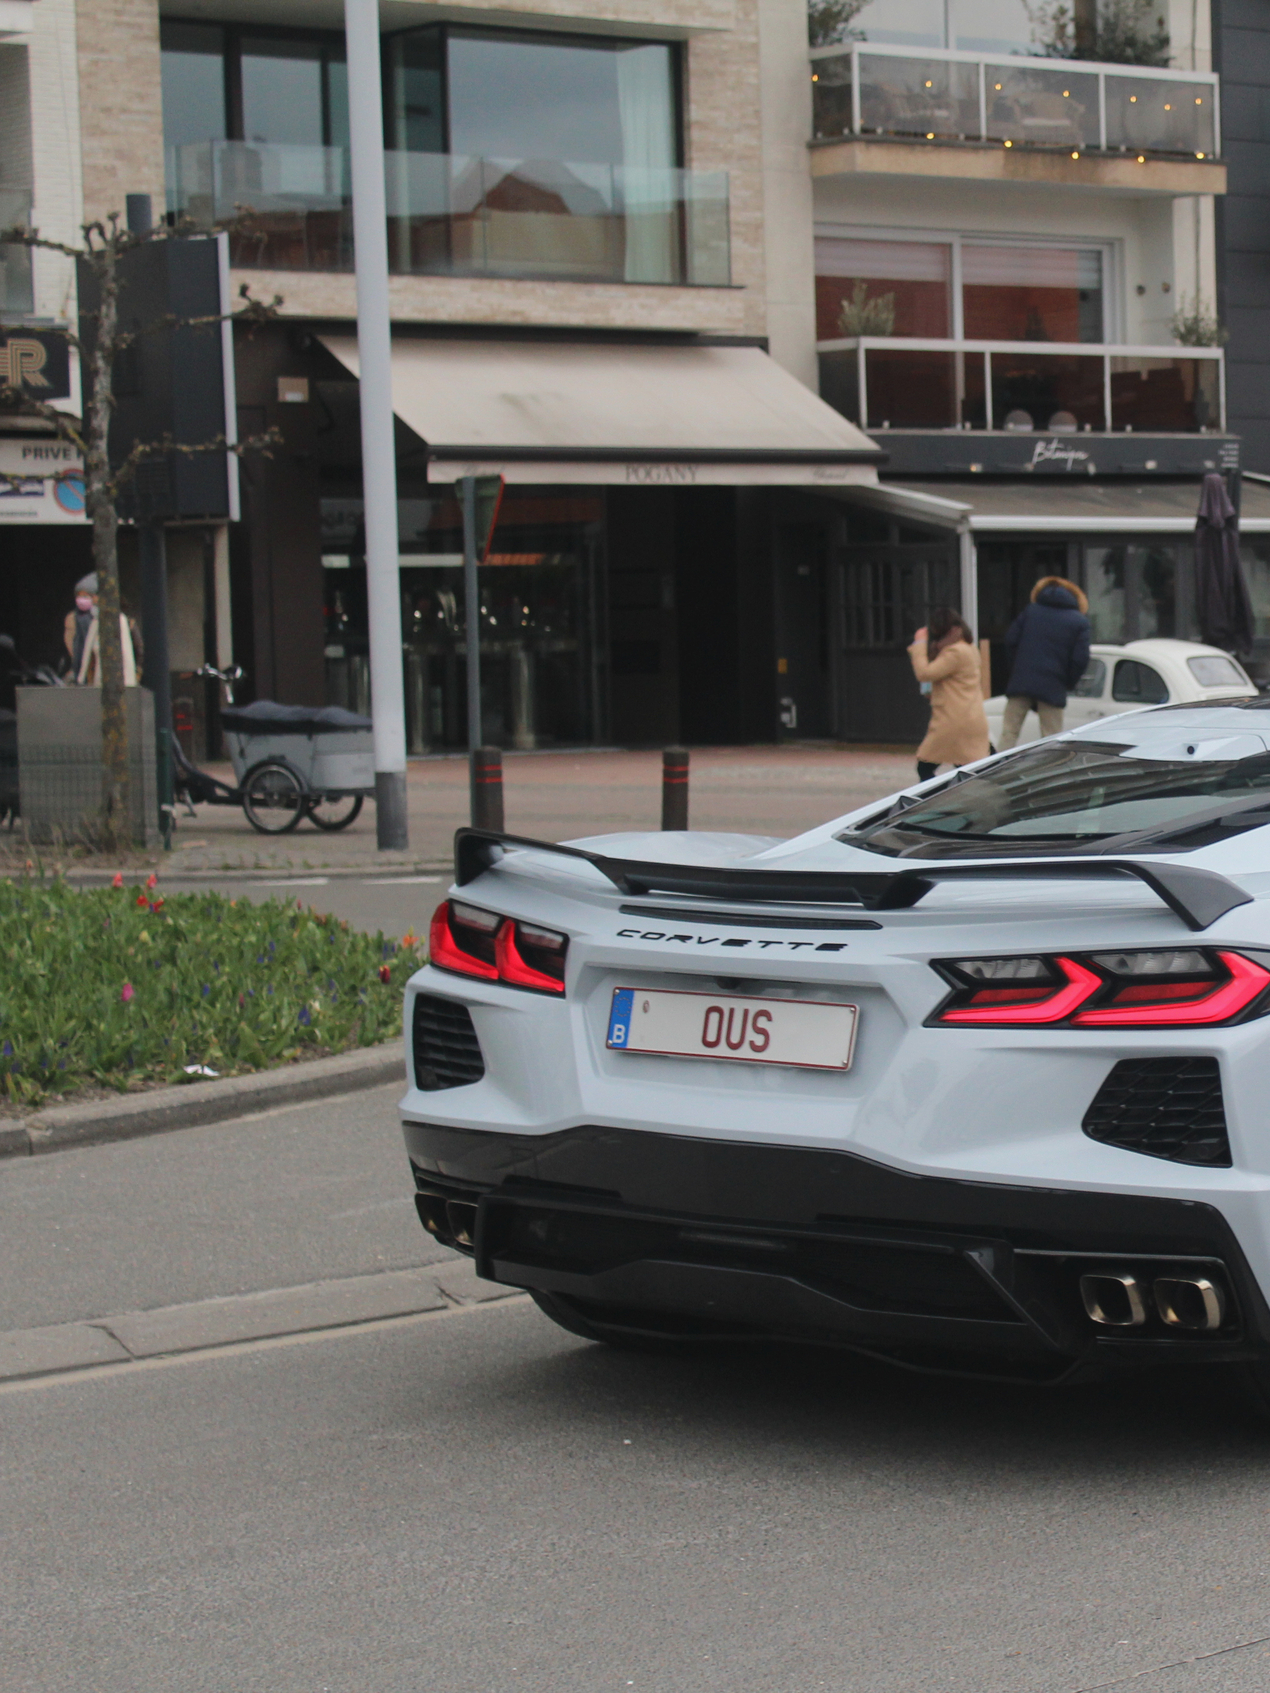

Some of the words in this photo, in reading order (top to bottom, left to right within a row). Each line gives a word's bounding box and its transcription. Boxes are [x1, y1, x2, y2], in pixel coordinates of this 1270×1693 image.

[22, 446, 71, 460] PRIVE
[616, 928, 849, 952] CORVETTE
[612, 1024, 626, 1044] B
[701, 1005, 773, 1053] OUS
